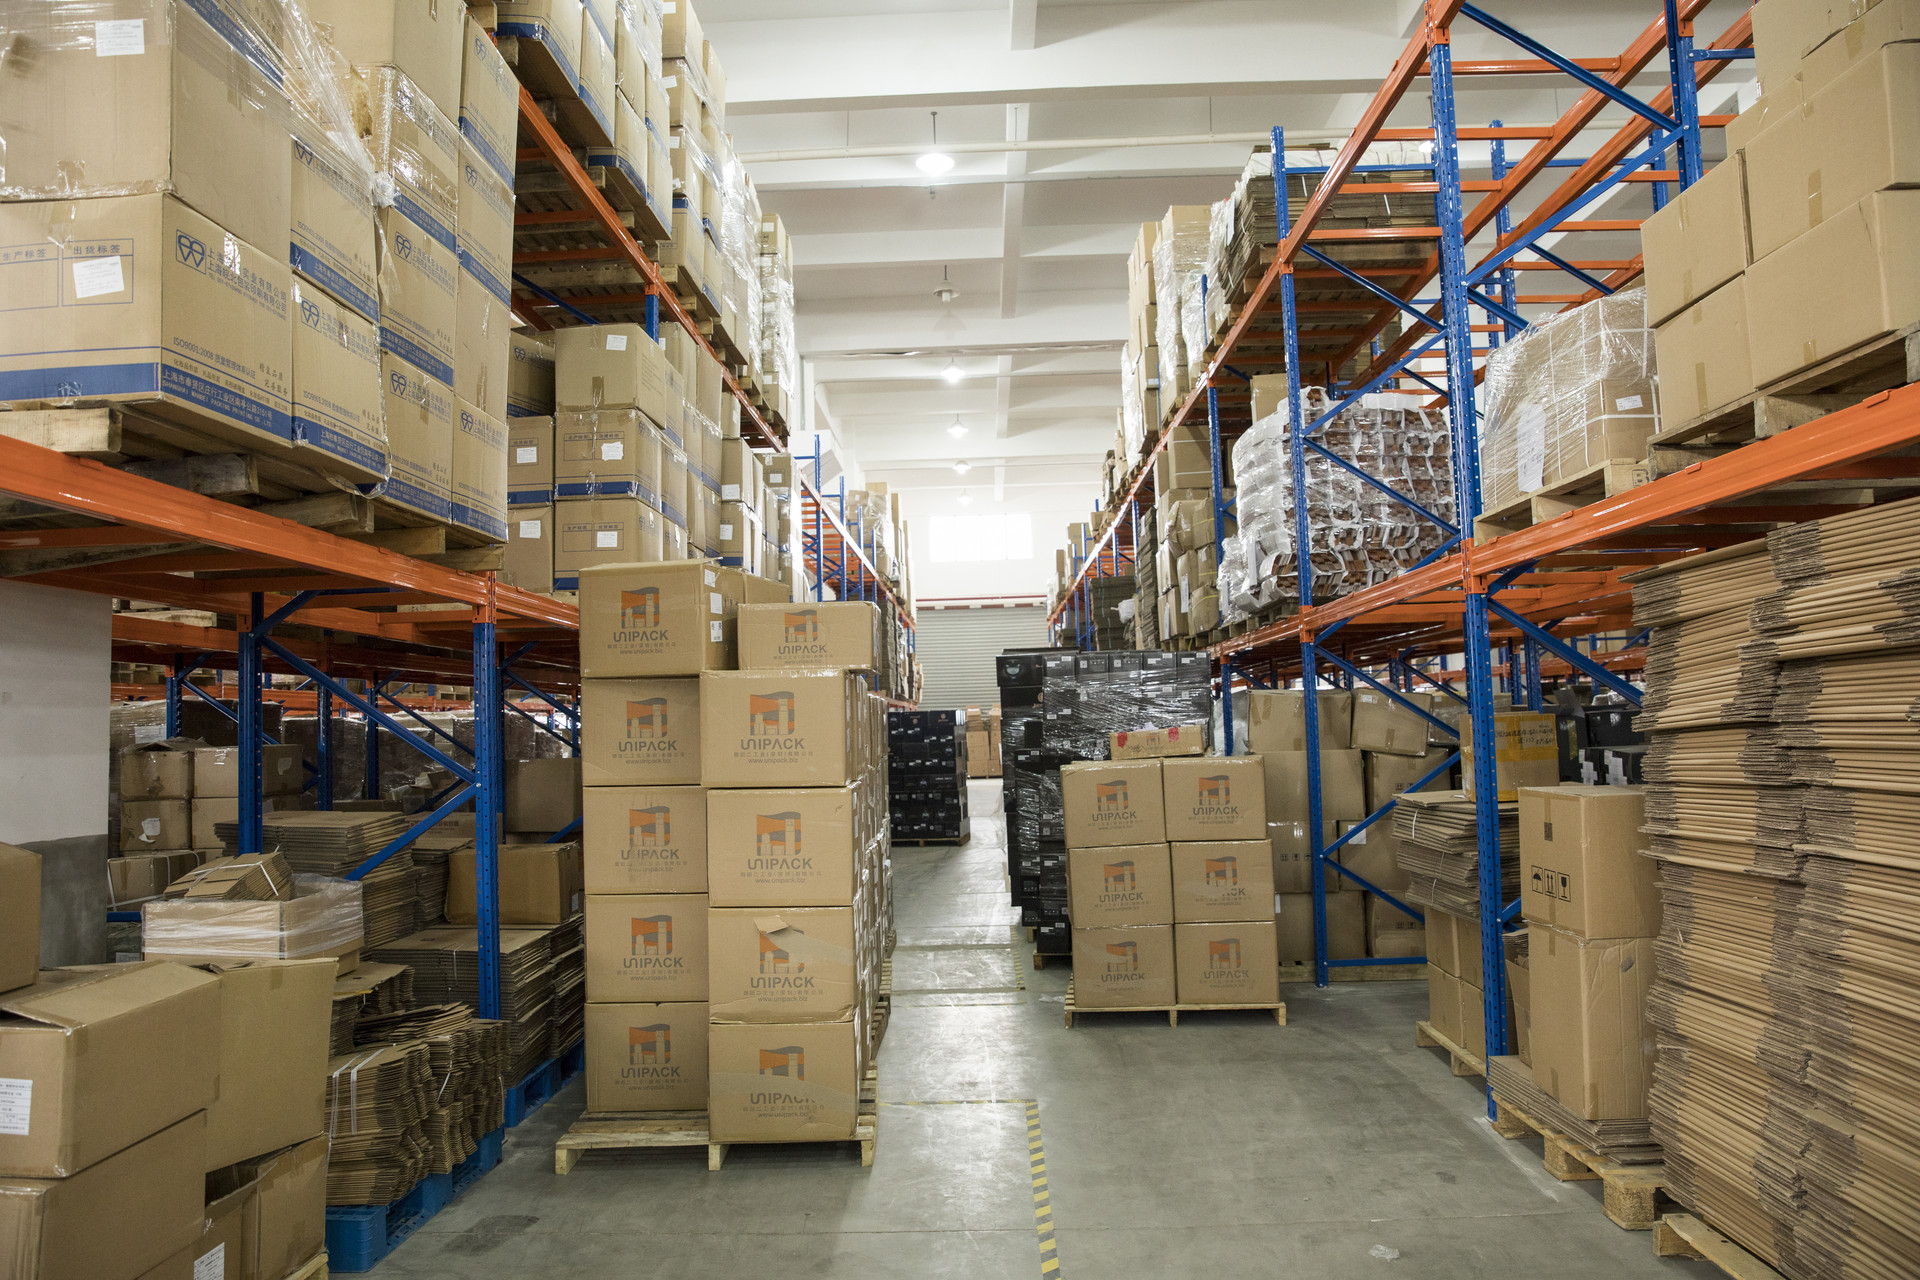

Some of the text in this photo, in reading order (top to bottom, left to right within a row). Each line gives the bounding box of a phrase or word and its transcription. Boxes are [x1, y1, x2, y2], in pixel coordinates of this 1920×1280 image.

[613, 630, 669, 642] UNIPACK
[778, 645, 827, 655] UNIPACK
[618, 740, 677, 752] UNIPACK
[740, 738, 805, 750] UNIPACK
[1091, 811, 1137, 822] UNIPACK
[1193, 806, 1239, 816] UNIPACK
[621, 848, 680, 860] UIPACK
[747, 858, 813, 870] UNIPACK
[1099, 892, 1144, 903] UNIPACK
[623, 957, 684, 969] UNIPACK
[1203, 970, 1250, 979] UNIPACK
[750, 976, 815, 989] UNIPACK
[621, 1066, 681, 1079] UNIPACK
